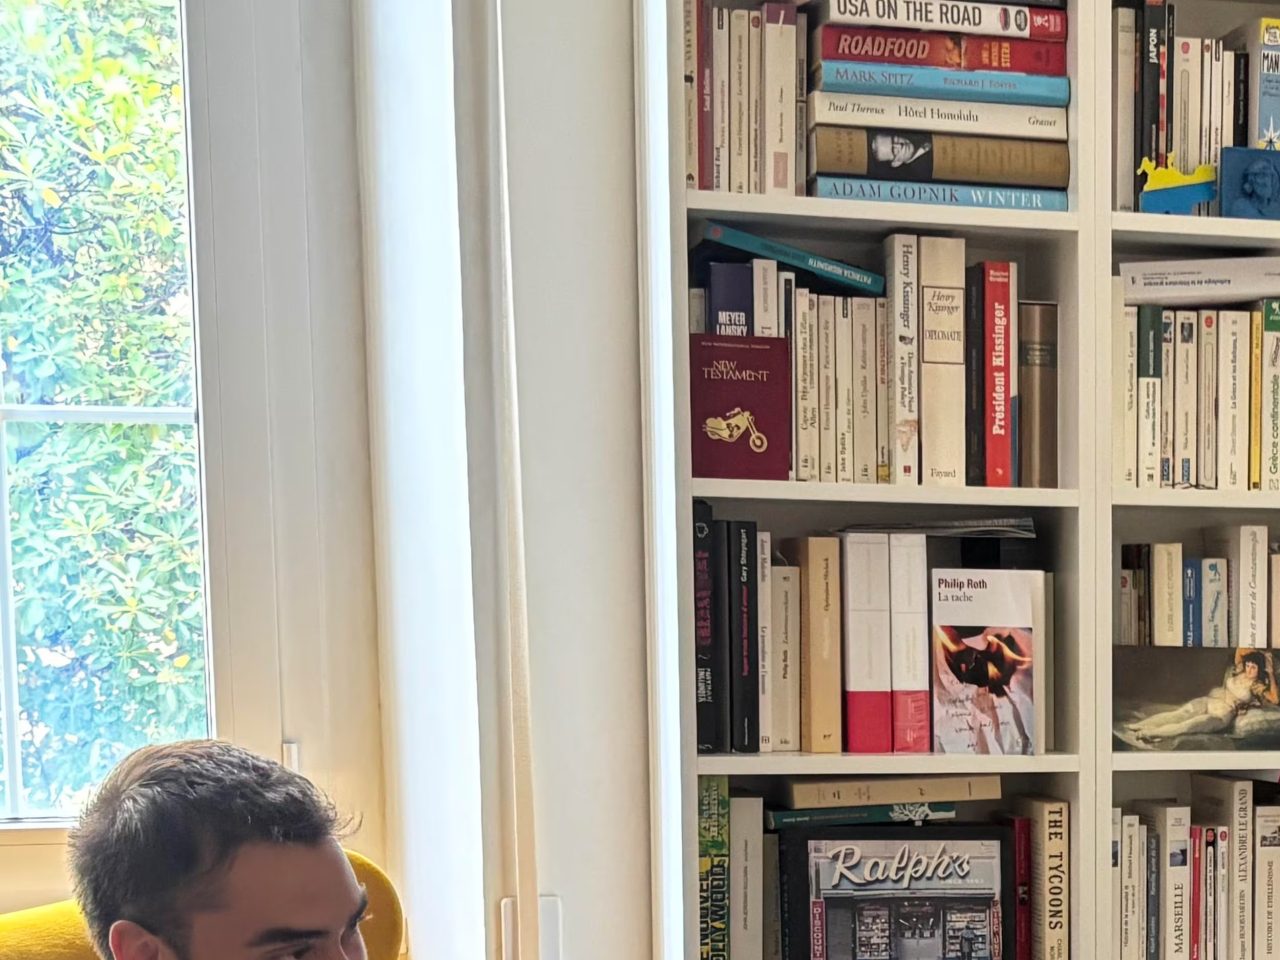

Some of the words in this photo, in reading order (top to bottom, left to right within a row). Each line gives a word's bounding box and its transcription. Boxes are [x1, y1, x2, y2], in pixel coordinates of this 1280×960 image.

[837, 0, 870, 17] USA
[875, 0, 898, 20] ON
[904, 1, 933, 23] THE
[939, 5, 982, 27] ROAD
[838, 34, 930, 59] ROADFOOD
[1148, 28, 1159, 63] JAPON
[835, 68, 877, 83] MARK
[881, 71, 914, 86] SPITZ
[828, 101, 848, 113] Paul
[850, 102, 886, 115] Theroux
[898, 103, 927, 119] Hôtel
[931, 107, 979, 123] Honolulu
[829, 182, 882, 199] ADAM
[889, 184, 958, 202] GOPNIK
[970, 189, 1042, 208] WINTER
[901, 243, 913, 274] Henry
[899, 276, 912, 330] Kissinger
[931, 290, 956, 303] Henry
[716, 325, 748, 335] LANSKY
[717, 311, 746, 325] MEYER
[991, 301, 1007, 367] Kissinger
[702, 369, 770, 382] TESTAMENT
[713, 359, 737, 370] NEW
[991, 368, 1006, 436] Président
[1269, 374, 1279, 439] continentale
[1269, 440, 1279, 475] Grèce
[931, 468, 956, 480] Fayard
[739, 528, 749, 565] Shteyngart
[740, 565, 749, 583] Gary
[938, 578, 965, 590] Philip
[966, 578, 988, 590] Roth
[938, 592, 949, 602] La
[951, 592, 974, 602] tache
[1239, 788, 1249, 819] GRAND
[1047, 807, 1063, 841] THE
[1238, 820, 1248, 832] LE
[826, 842, 970, 888] Ralph's
[1238, 832, 1248, 884] ALEXANDRE
[1047, 851, 1064, 931] TYCOONS
[1265, 860, 1274, 909] L'HELLÉNISME
[1173, 882, 1184, 954] MARSEILLE
[1266, 910, 1273, 921] DE
[813, 906, 823, 958] DISCOUNT
